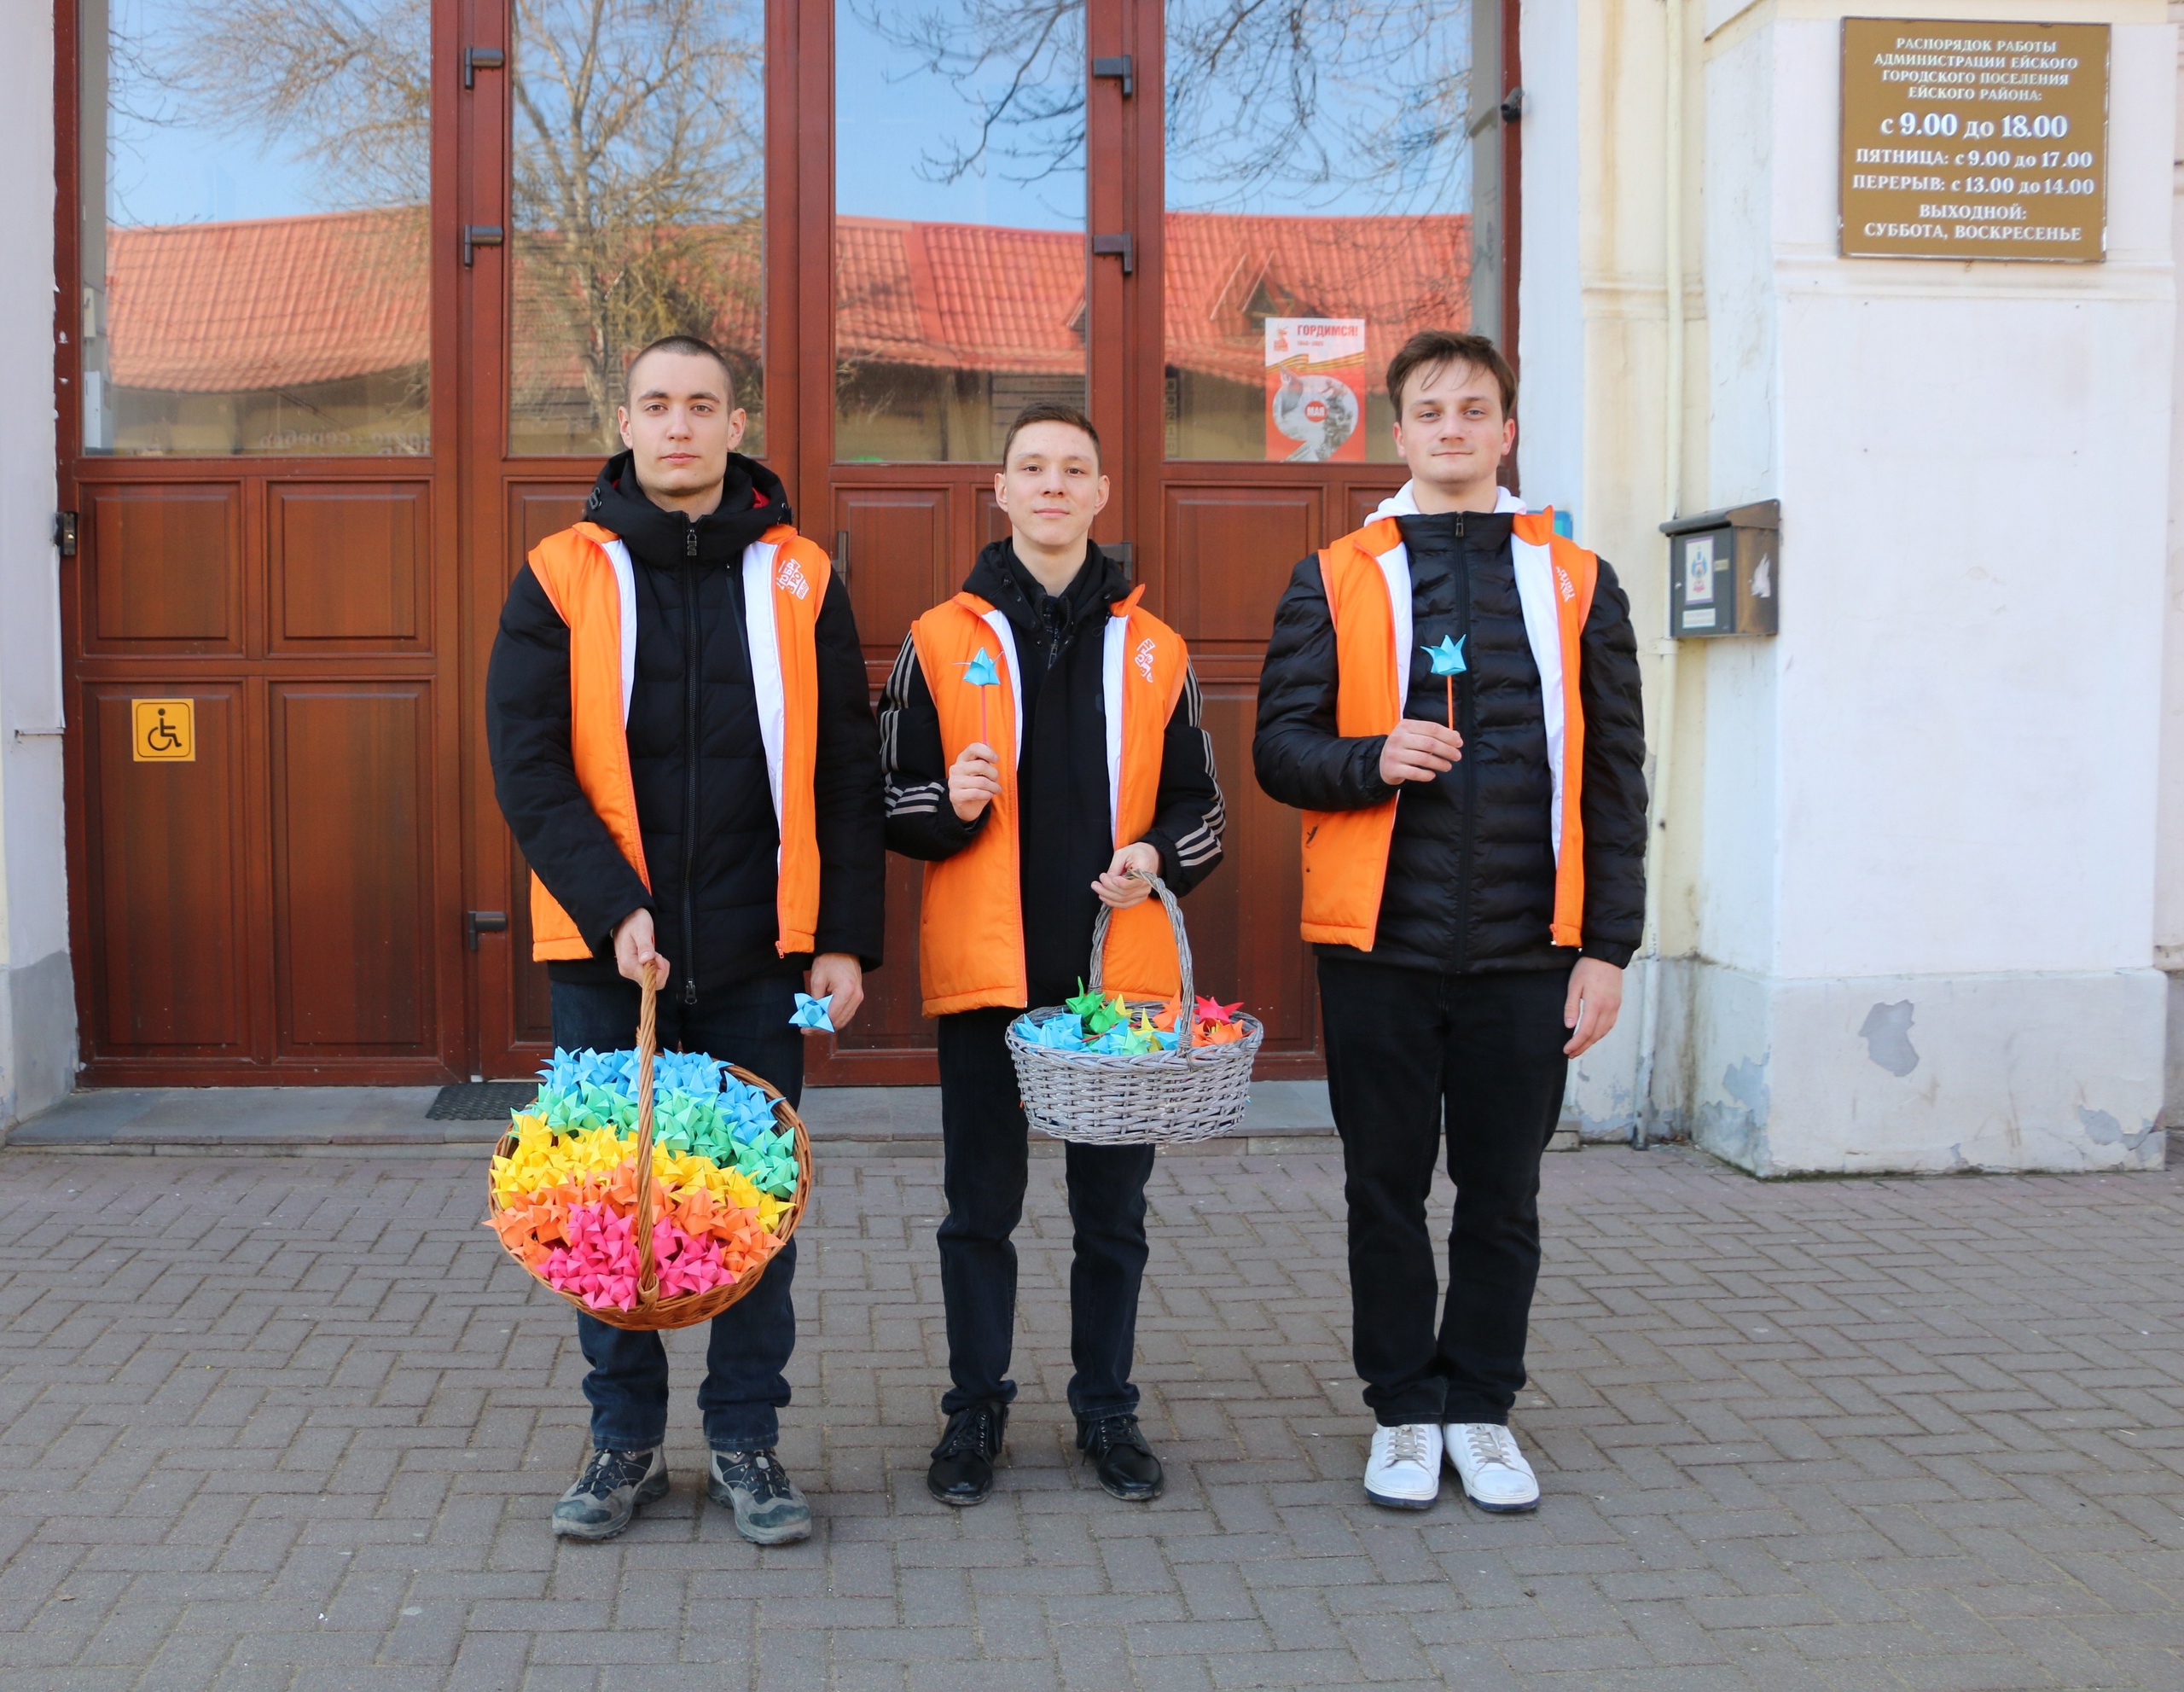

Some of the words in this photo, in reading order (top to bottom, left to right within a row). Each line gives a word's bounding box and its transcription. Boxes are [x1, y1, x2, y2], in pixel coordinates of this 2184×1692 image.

[1896, 38, 1991, 52] РАСПОРЯДОК
[1996, 41, 2057, 53] РАБОТЫ
[1874, 55, 2006, 67] АДМИНИСТРАЦИИ
[2011, 55, 2078, 69] ЕЙСКОГО
[1883, 70, 1976, 84] ГОРОДСКОГО
[1980, 73, 2070, 85] ПОСЕЛЕНИЯ
[1908, 86, 1976, 99] ЕЙСКОГО
[1979, 88, 2041, 101] РАЙОНА:
[1880, 119, 1893, 135] с
[1899, 112, 1958, 136] 9.00
[1963, 121, 1995, 139] до
[2002, 115, 2068, 138] 18.00
[1856, 149, 1948, 165] ПЯТНИЦА:
[1955, 154, 1964, 165] с
[1967, 151, 2011, 166] 9.00
[2014, 156, 2036, 167] до
[2042, 152, 2093, 167] 17.00
[1853, 175, 1944, 190] ПЕРЕРЫВ:
[1951, 181, 1960, 191] с
[1966, 177, 2014, 193] 13.00
[2018, 182, 2041, 194] до
[2044, 179, 2094, 195] 14.00
[1920, 204, 2026, 220] ВЫХОДНОЙ:
[1864, 224, 1947, 239] СУББОТА,
[1955, 226, 2081, 241] ВОСКРЕСЕНЬЕ
[1298, 325, 1358, 337] ГОРДИМСЯ!
[1307, 406, 1325, 416] МАЯ
